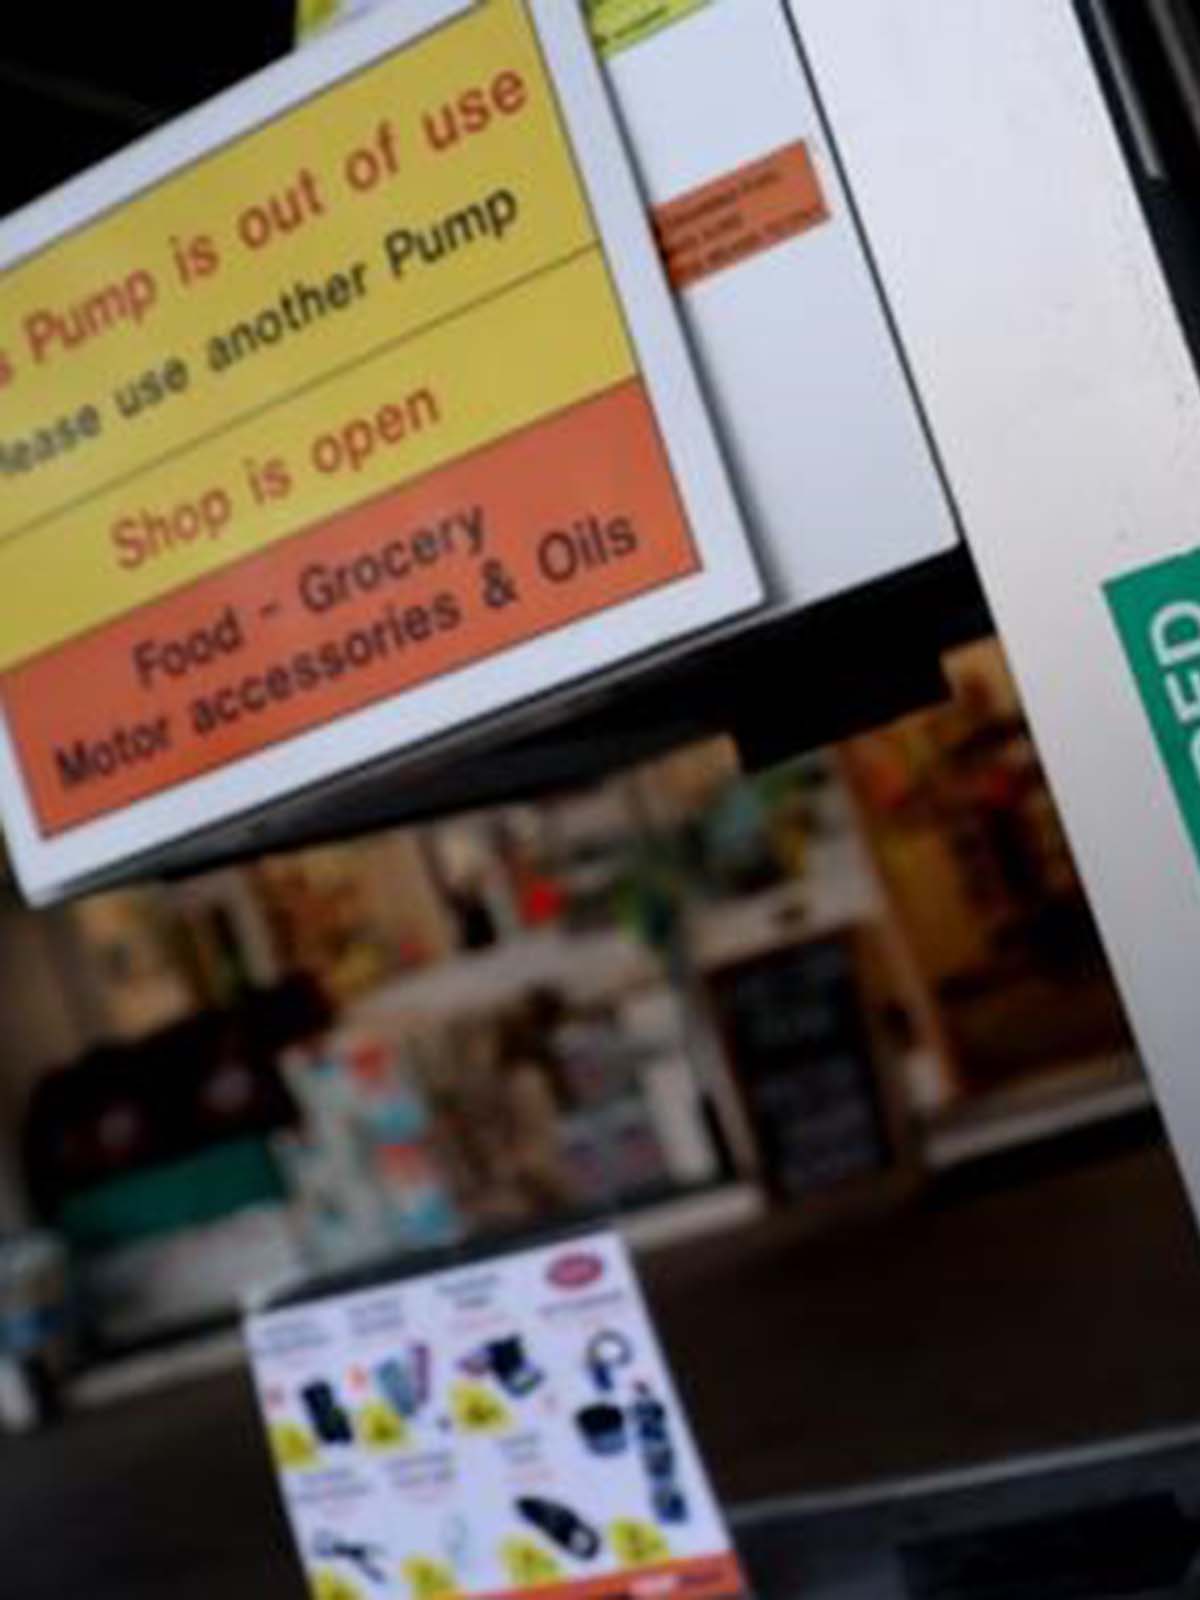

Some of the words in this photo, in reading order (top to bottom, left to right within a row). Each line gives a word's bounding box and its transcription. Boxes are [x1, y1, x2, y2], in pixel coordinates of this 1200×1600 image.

[23, 268, 157, 364] Pump
[170, 233, 220, 288] is
[237, 168, 325, 252] out
[343, 120, 399, 194] of
[419, 68, 528, 153] use
[114, 356, 188, 419] use
[206, 259, 368, 372] another
[383, 186, 520, 279] Pump
[109, 487, 234, 570] Shop
[244, 456, 293, 506] is
[310, 386, 441, 473] open
[54, 714, 172, 792] Motor
[190, 592, 463, 736] accessories
[481, 560, 517, 607] &
[537, 514, 638, 584] Oils
[131, 607, 243, 690] Food
[299, 504, 486, 613] Grocery
